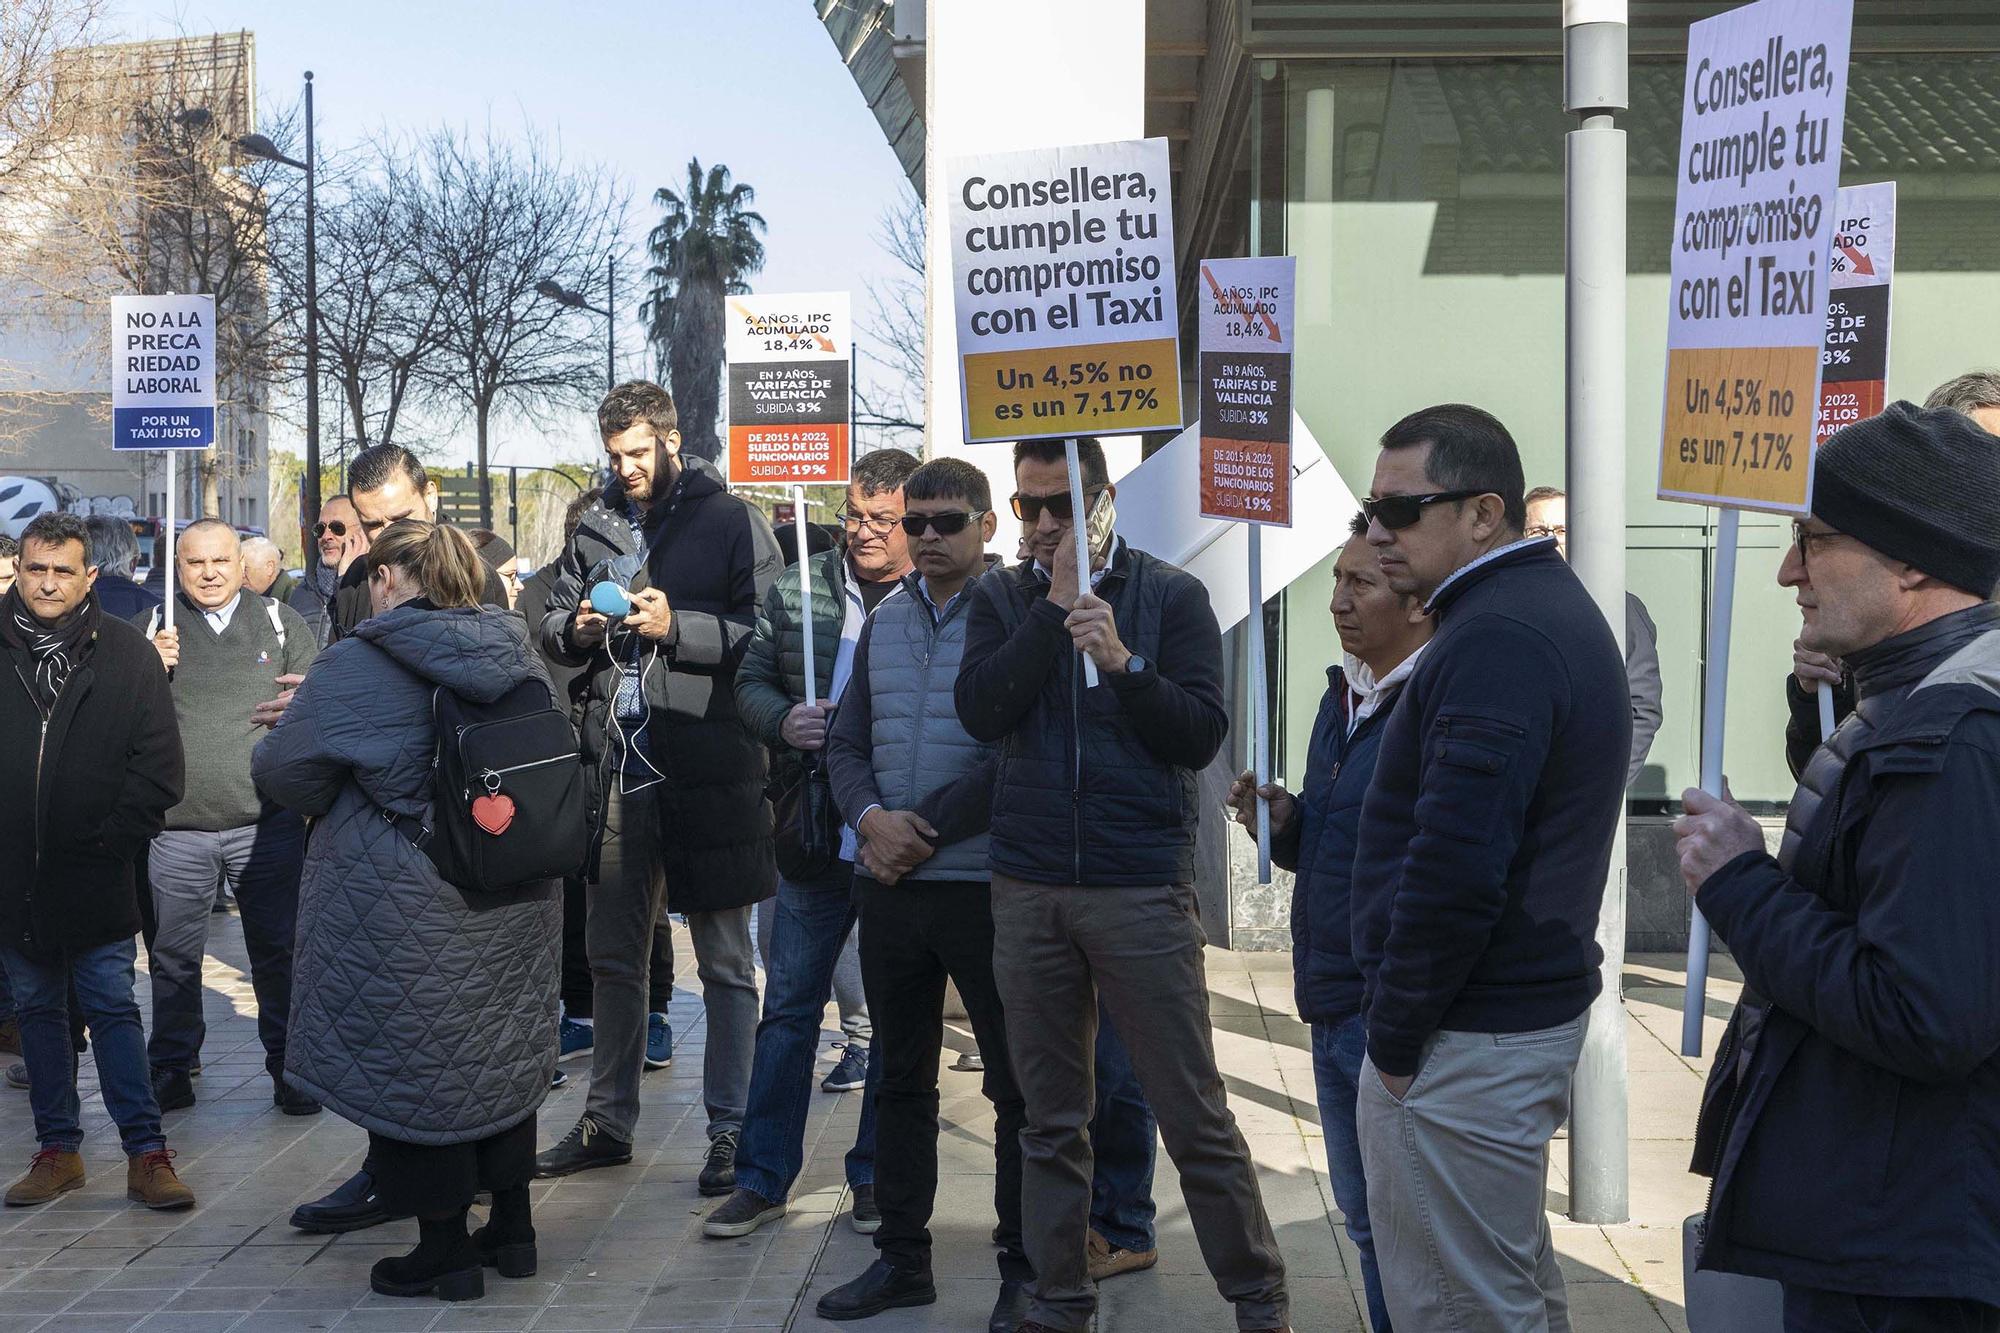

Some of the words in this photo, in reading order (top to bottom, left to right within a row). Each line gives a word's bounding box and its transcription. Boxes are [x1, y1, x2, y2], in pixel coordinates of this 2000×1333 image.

[1693, 36, 1833, 116] Consellera,
[1689, 110, 1786, 188] cumple
[1795, 110, 1830, 166] tu
[962, 167, 1156, 212] Consellera,
[1682, 179, 1822, 260] compromiso
[1840, 217, 1870, 232] IPC
[965, 209, 1106, 254] cumple
[1116, 208, 1157, 241] tu
[967, 247, 1160, 297] compromiso
[1213, 287, 1219, 299] 6
[1221, 285, 1257, 300] AÑOS,
[1259, 287, 1279, 299] IPC
[1679, 275, 1720, 321] con
[1727, 256, 1751, 317] el
[1758, 251, 1816, 316] Taxi
[970, 306, 1036, 336] con
[1047, 293, 1079, 330] el
[1086, 286, 1163, 326] Taxi
[1214, 303, 1276, 315] ACUMULADO
[1828, 302, 1849, 316] OS,
[127, 312, 156, 328] NO
[160, 312, 174, 327] A
[179, 312, 201, 327] LA
[745, 315, 753, 325] 6
[757, 313, 803, 324] AÑOS,
[807, 313, 832, 322] IPC
[1840, 315, 1866, 329] DE
[747, 325, 829, 336] ACUMULADO
[1226, 322, 1264, 339] 18,4%
[128, 334, 201, 350] PRECA
[764, 339, 813, 351] 18,4%
[128, 356, 200, 372] RIEDAD
[1822, 349, 1851, 365] 3%
[759, 372, 774, 380] EN
[776, 371, 782, 379] 9
[784, 368, 817, 380] AÑOS,
[996, 369, 1034, 390] Un
[1042, 361, 1109, 389] 4,5%
[1119, 363, 1152, 382] no
[1222, 366, 1233, 376] EN
[1234, 366, 1240, 377] 9
[1241, 364, 1266, 378] AÑOS,
[127, 378, 201, 394] LABORAL
[745, 381, 807, 390] TARIFAS
[811, 379, 832, 388] DE
[1213, 379, 1258, 391] TARIFAS
[1260, 380, 1277, 392] DE
[750, 390, 826, 400] VALENCIA
[1216, 392, 1273, 406] VALENCIA
[1686, 379, 1710, 416] Un
[1715, 379, 1762, 421] 4,5%
[1768, 388, 1794, 418] no
[1824, 393, 1859, 407] 2022,
[756, 403, 794, 414] SUBIDA
[796, 402, 821, 413] 3%
[994, 403, 1023, 420] es
[1033, 400, 1065, 418] un
[1073, 387, 1159, 417] 7,17%
[142, 416, 167, 426] POR
[171, 416, 190, 425] UN
[1219, 409, 1248, 423] SUBIDA
[1249, 410, 1268, 425] 3%
[1833, 408, 1859, 420] LOS
[130, 429, 158, 439] TAXI
[161, 428, 201, 438] JUSTO
[748, 434, 762, 442] DE
[765, 433, 789, 441] 2015
[792, 433, 799, 441] A
[802, 432, 829, 442] 2022,
[748, 443, 790, 452] SUELDO
[793, 442, 806, 451] DE
[809, 442, 829, 451] LOS
[1680, 436, 1698, 464] es
[1703, 438, 1726, 466] un
[1731, 432, 1793, 475] 7,17%
[748, 452, 829, 462] FUNCIONARIOS
[1214, 450, 1225, 460] DE
[1226, 450, 1243, 462] 2015
[1244, 452, 1251, 463] A
[1252, 453, 1273, 466] 2022,
[751, 465, 788, 476] SUBIDA
[791, 464, 827, 475] 19%
[1214, 462, 1244, 476] SUELDO
[1245, 465, 1257, 477] DE
[1258, 466, 1273, 479] LOS
[1214, 476, 1273, 492] FUNCIONARIOS
[1216, 493, 1243, 507] SUBIDA
[1244, 496, 1271, 512] 19%
